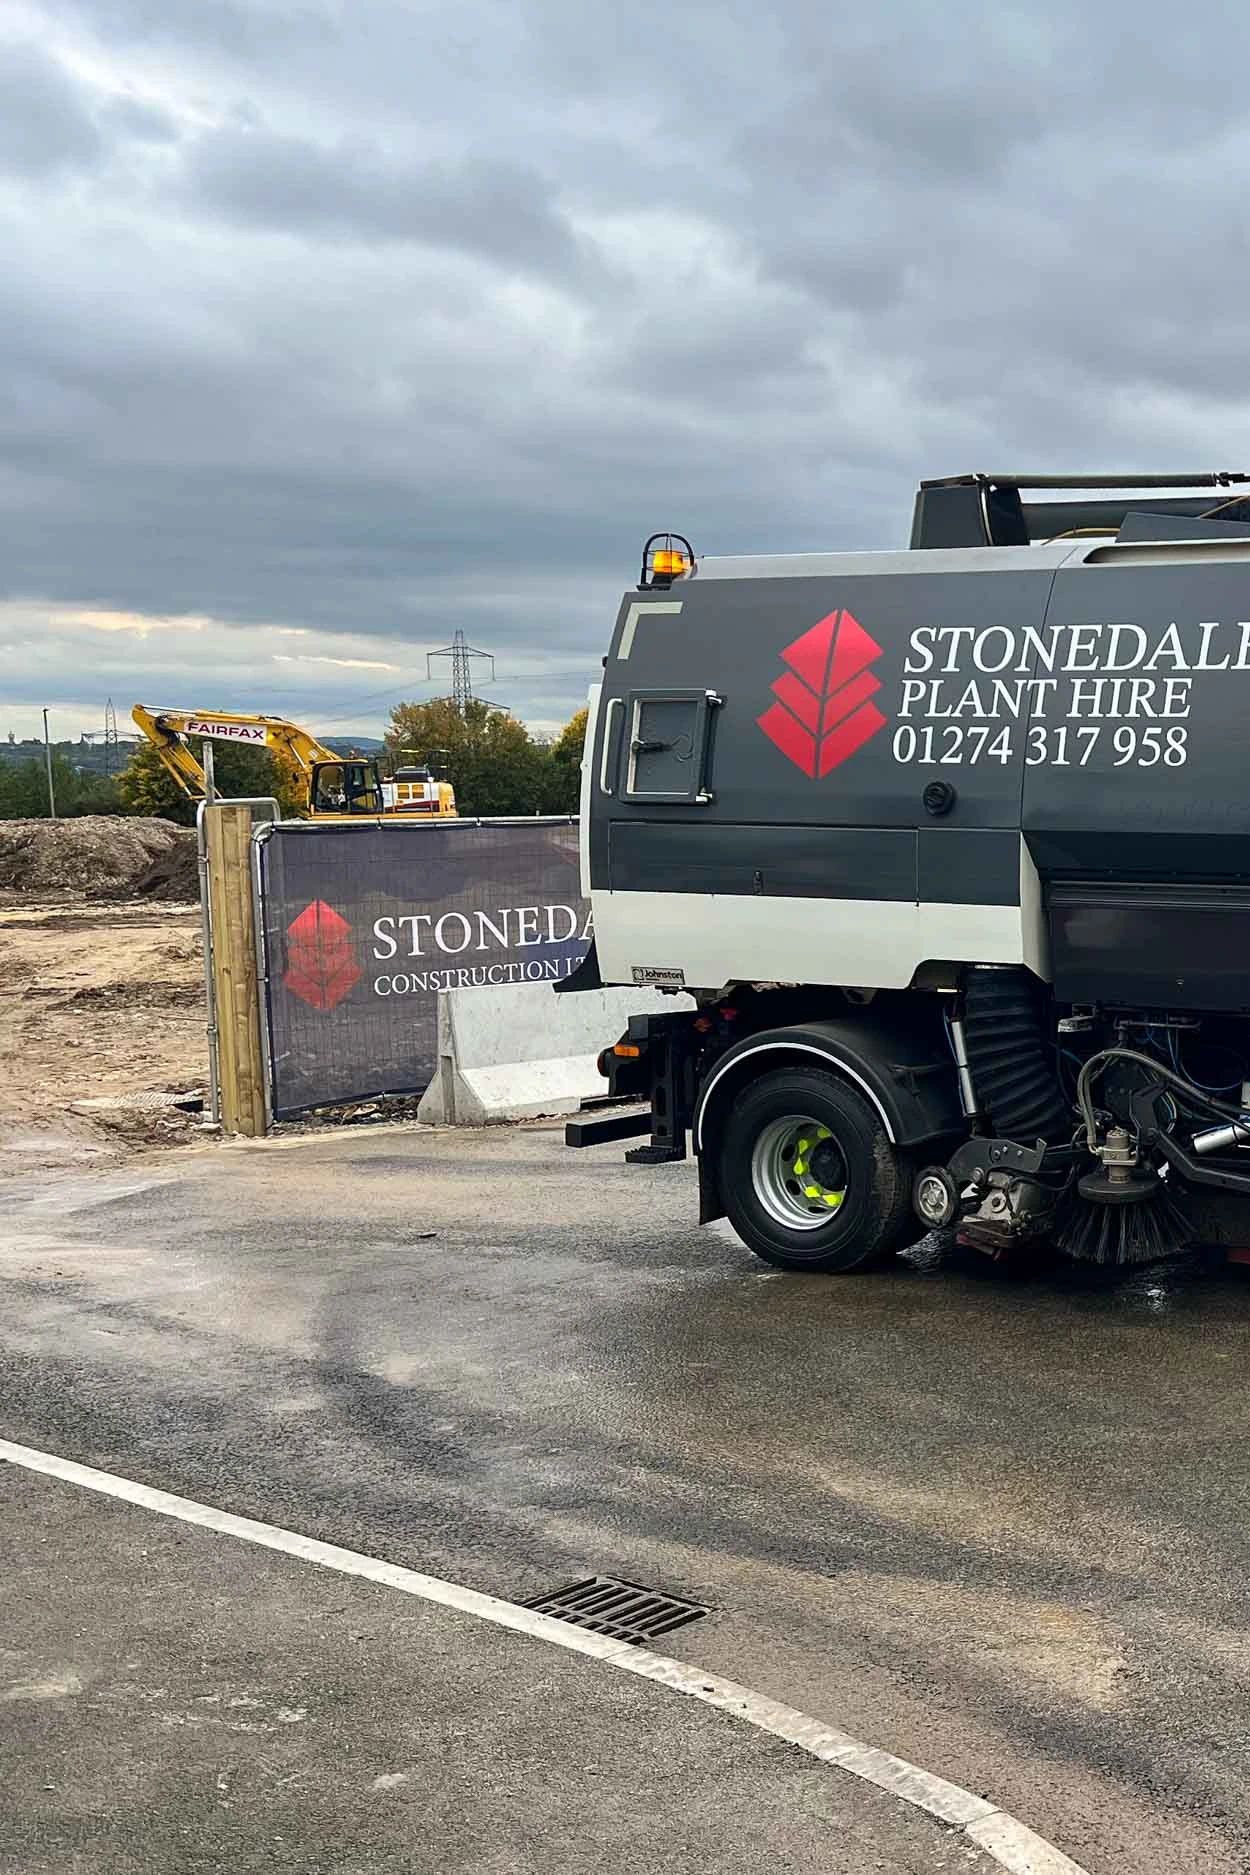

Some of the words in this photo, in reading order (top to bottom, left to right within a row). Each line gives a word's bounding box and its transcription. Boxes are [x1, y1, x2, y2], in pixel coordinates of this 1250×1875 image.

[896, 679, 1057, 719] PLANT
[1066, 678, 1192, 718] HIRE
[186, 721, 265, 740] FAIRFAX
[892, 725, 1013, 765] 01274
[1025, 725, 1100, 766] 317
[1112, 726, 1188, 766] 958
[373, 905, 595, 960] STONEDA
[374, 960, 560, 996] CONSTRUCTION
